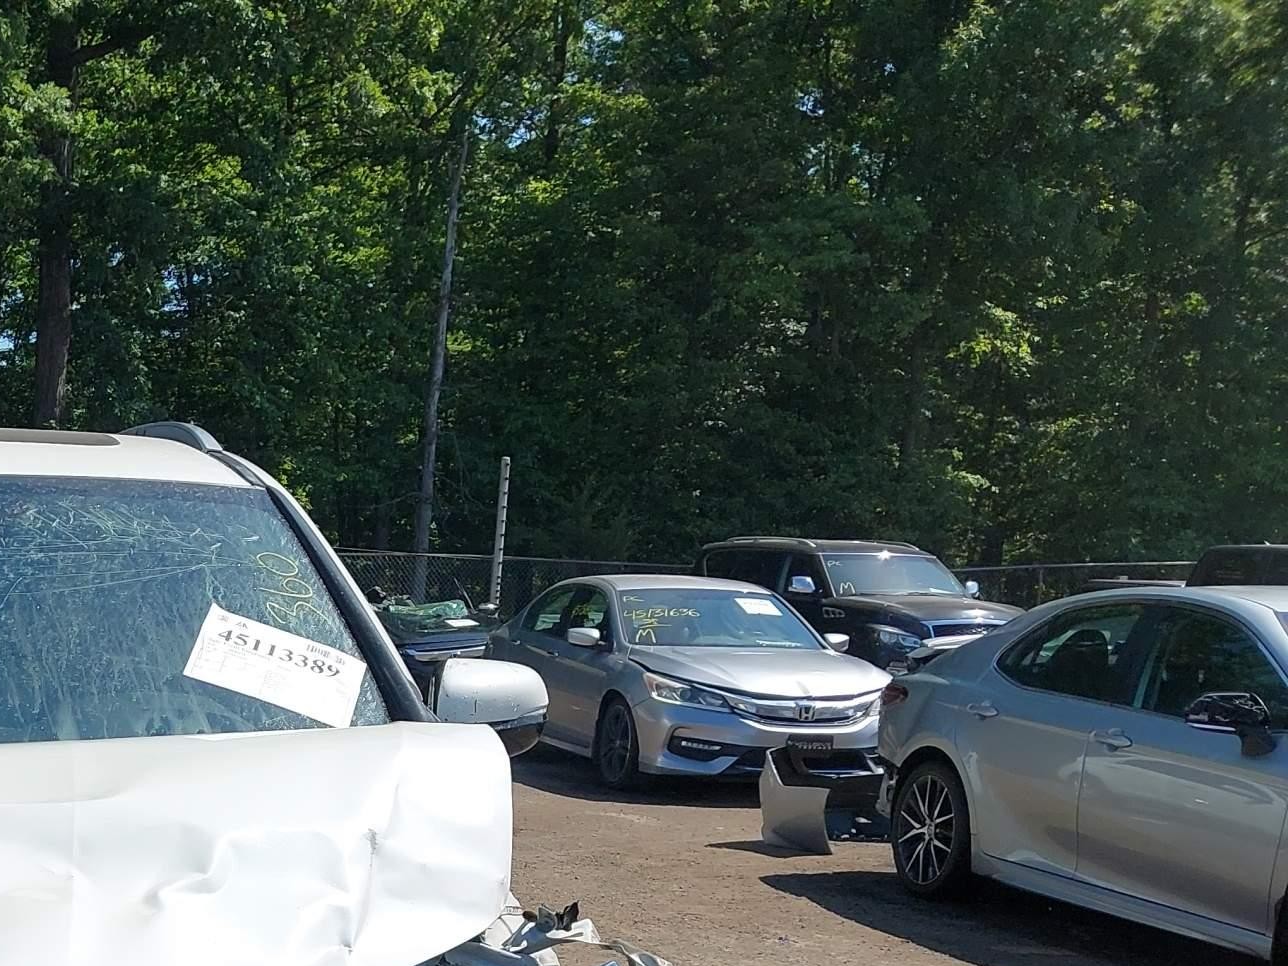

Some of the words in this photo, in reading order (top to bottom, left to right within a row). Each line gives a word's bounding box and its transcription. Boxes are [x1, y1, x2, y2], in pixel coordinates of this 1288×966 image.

[256, 552, 328, 624] 360
[217, 629, 341, 678] 45113389
[635, 628, 657, 644] M
